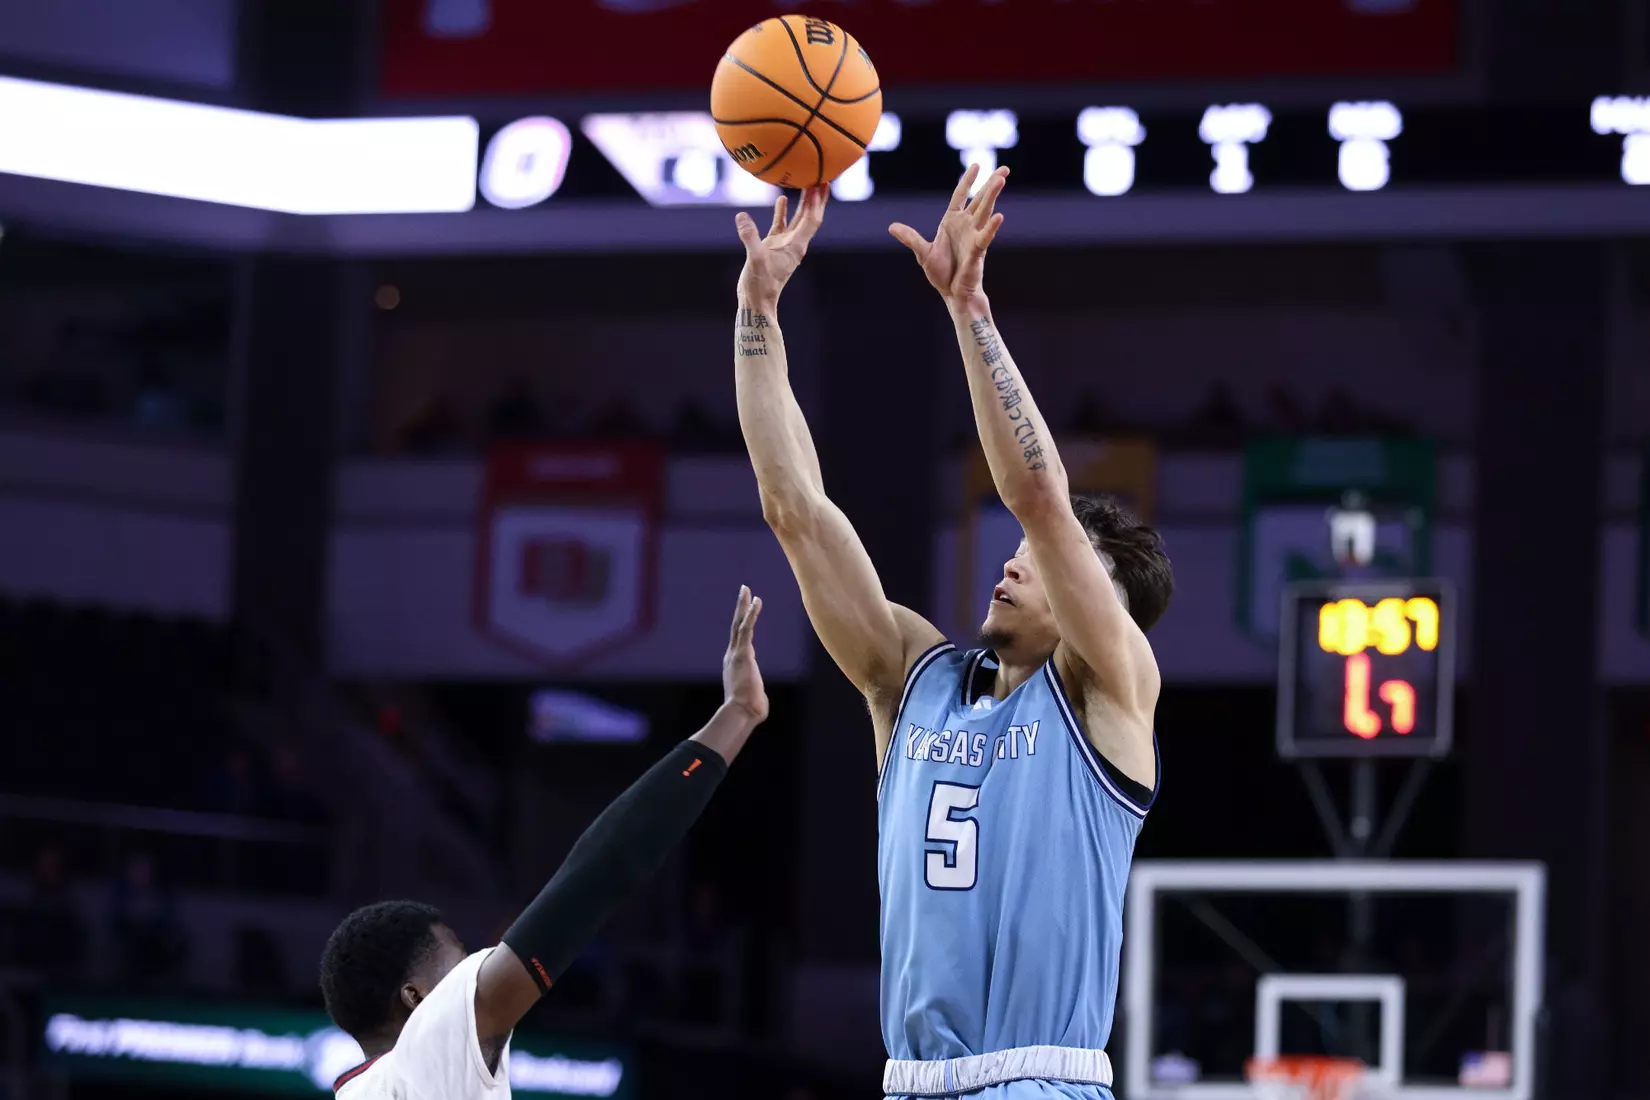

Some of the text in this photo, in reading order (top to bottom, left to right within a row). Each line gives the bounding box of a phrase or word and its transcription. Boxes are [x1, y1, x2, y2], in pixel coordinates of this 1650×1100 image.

[738, 331, 766, 342] arius
[739, 344, 767, 356] Omari
[923, 779, 982, 891] 5
